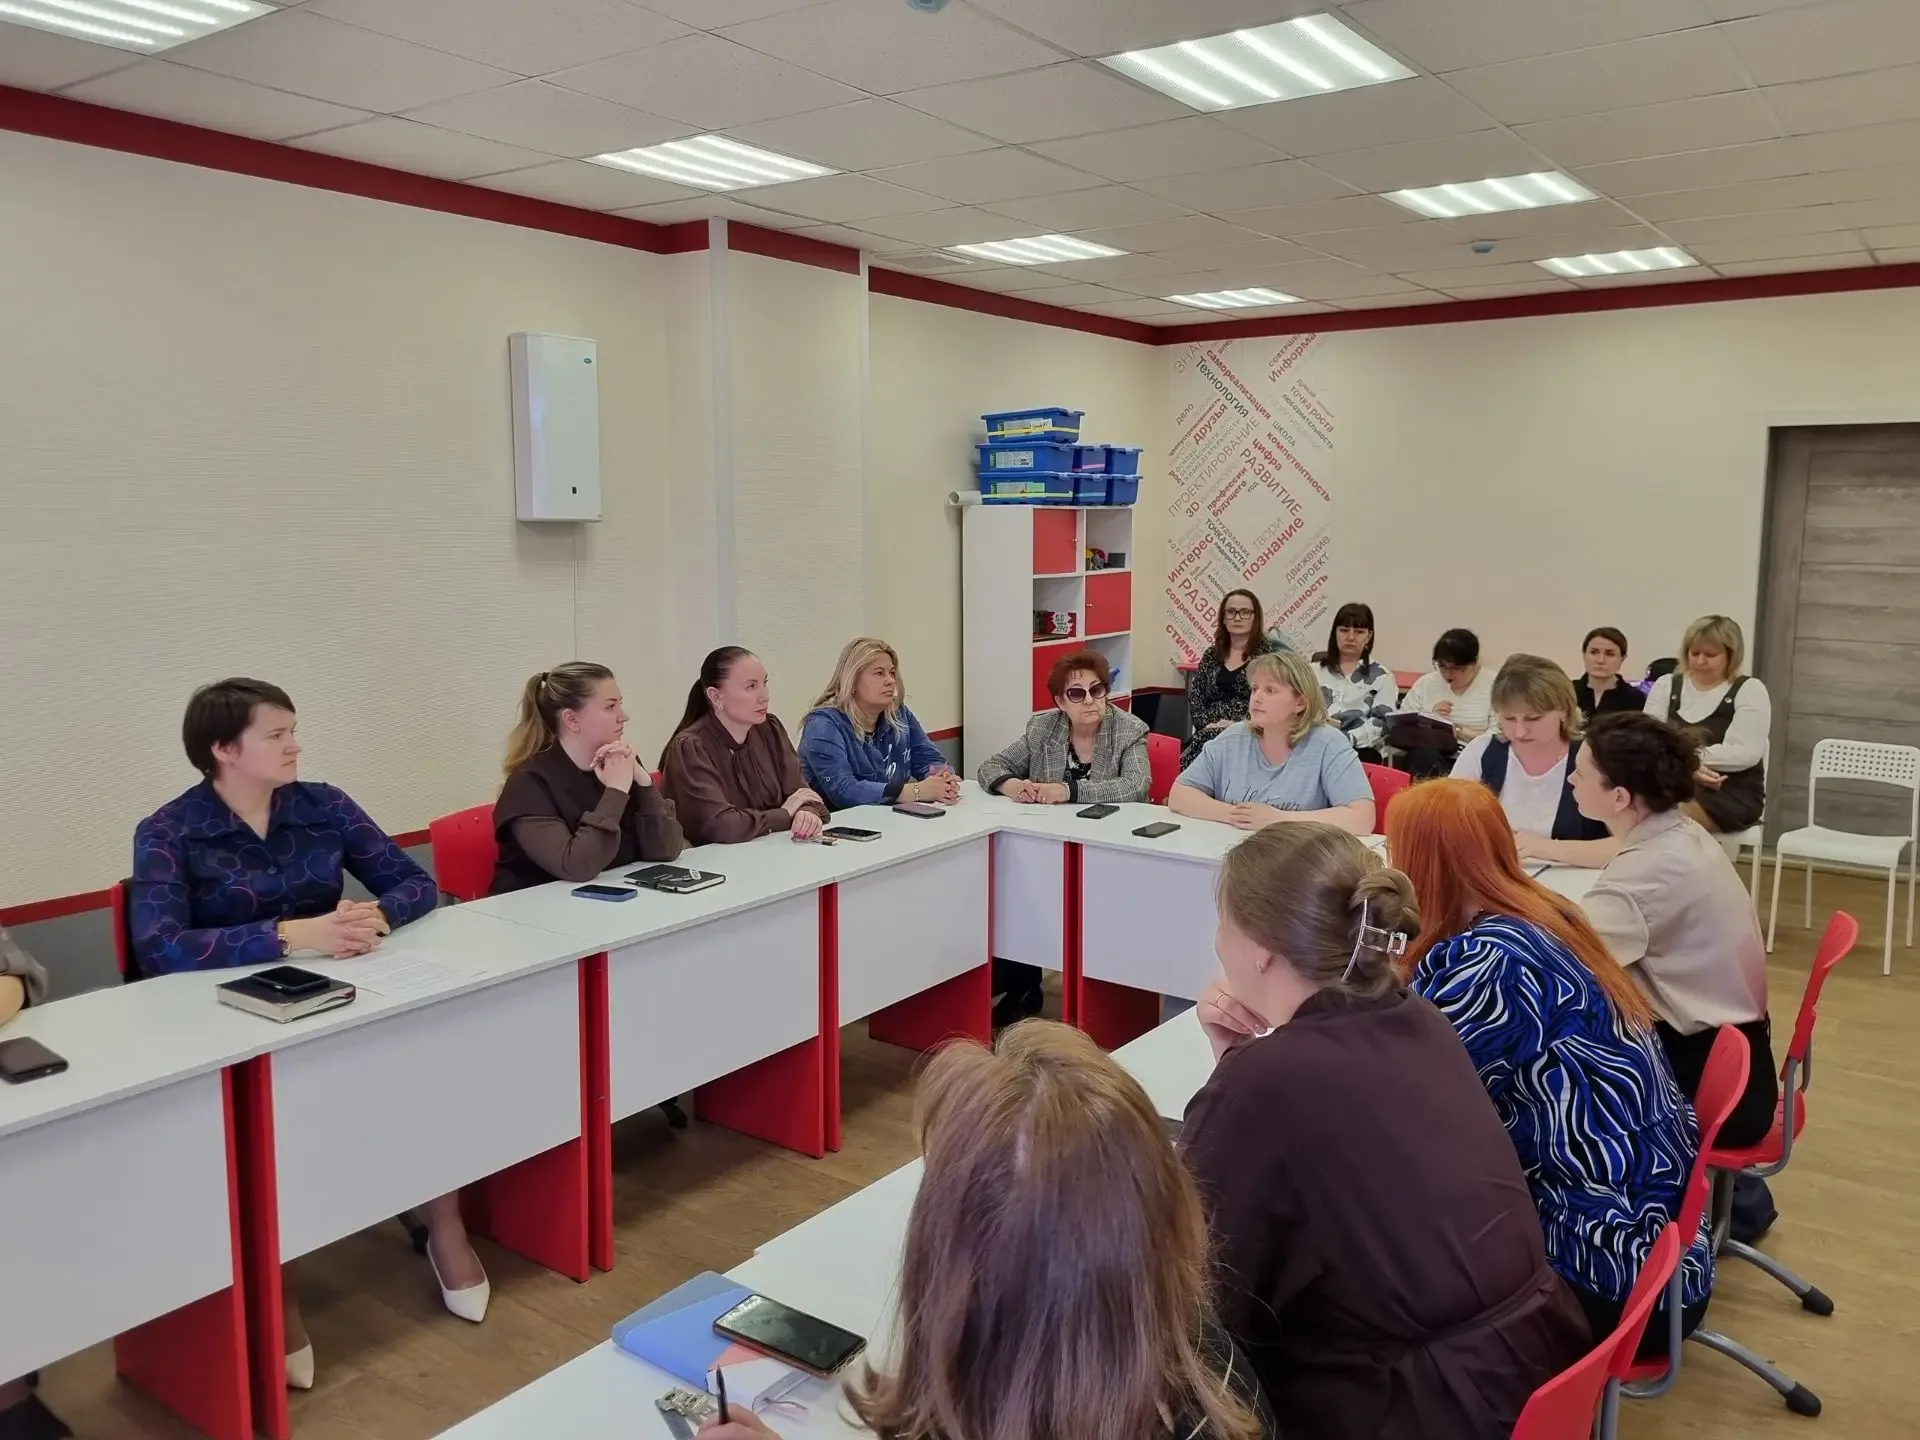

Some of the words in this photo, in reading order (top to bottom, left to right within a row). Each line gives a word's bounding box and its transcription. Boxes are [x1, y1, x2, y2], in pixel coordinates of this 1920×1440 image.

[1195, 355, 1249, 418] Технология
[1206, 349, 1272, 420] самореализация
[1176, 403, 1194, 426] дело
[1193, 403, 1228, 445] друзья
[1290, 386, 1312, 410] точка
[1309, 408, 1334, 433] роста
[1168, 415, 1261, 517] ПРОЕКТИРОВАНИЕ
[1168, 470, 1185, 487] рост
[1252, 438, 1283, 472] цифра
[1266, 431, 1331, 502] компетентность
[1206, 467, 1247, 511] профессии
[1212, 480, 1247, 518] будущего
[1240, 448, 1303, 517] РАЗВИТИЕ
[1186, 501, 1200, 518] 3D
[1168, 533, 1214, 583] интерес
[1205, 518, 1227, 544] ТОЧКА
[1225, 541, 1248, 568] РОСТА
[1242, 517, 1305, 582] познание
[1285, 536, 1331, 584] движение
[1297, 552, 1331, 587] ПРОЕКТ
[1272, 575, 1328, 628] еативность
